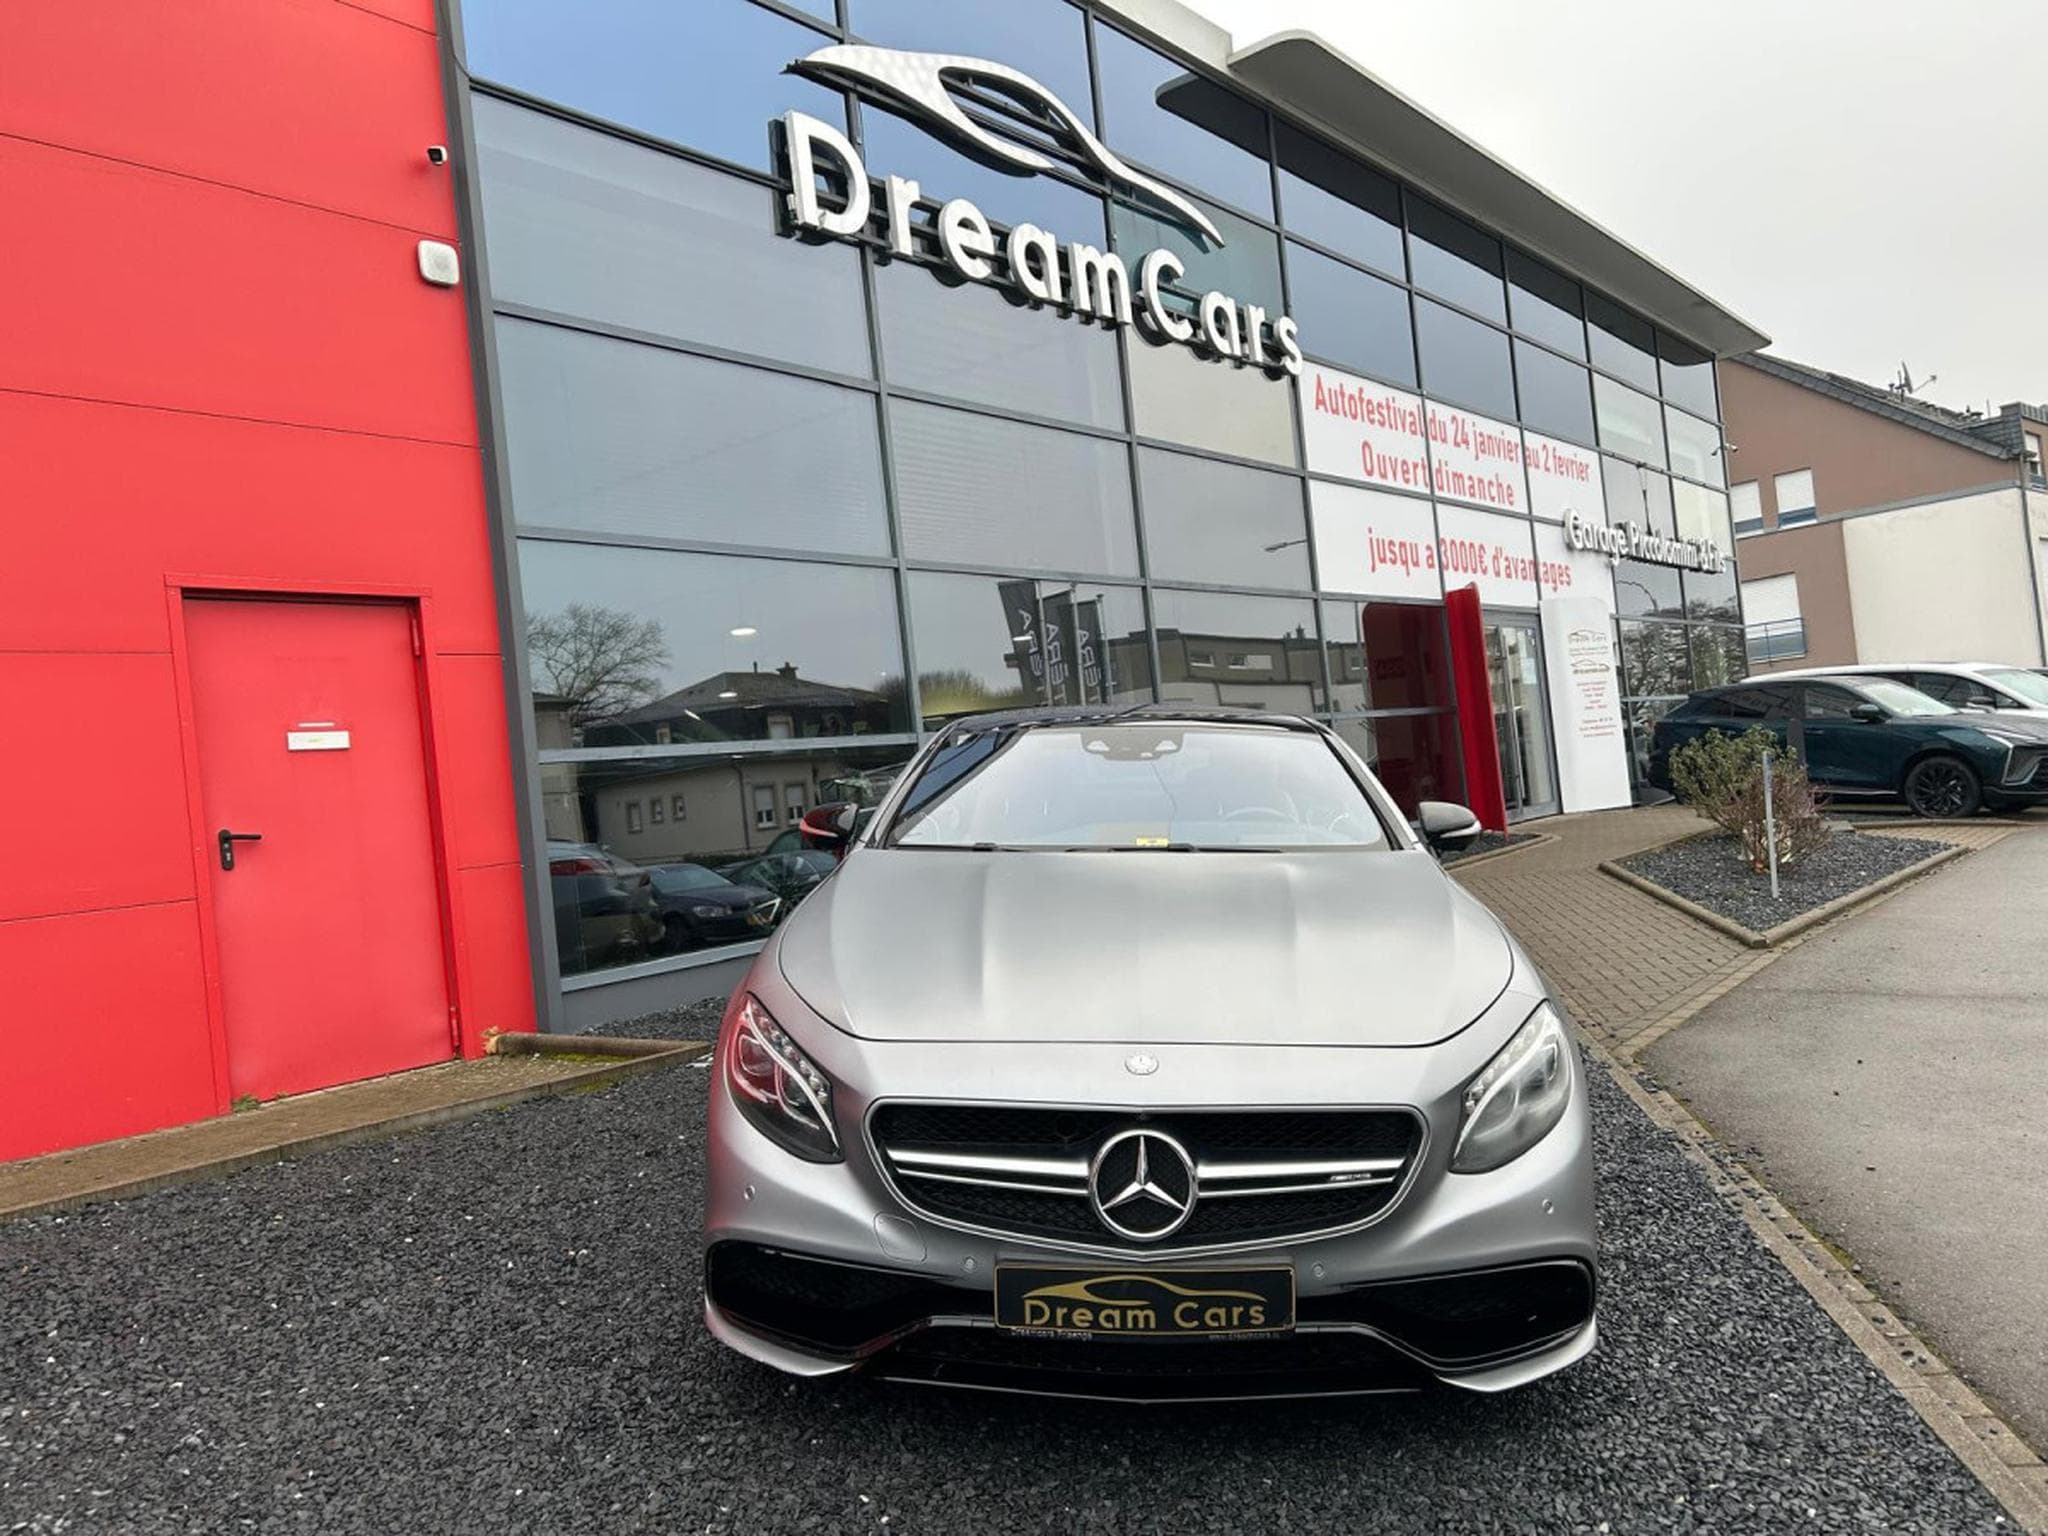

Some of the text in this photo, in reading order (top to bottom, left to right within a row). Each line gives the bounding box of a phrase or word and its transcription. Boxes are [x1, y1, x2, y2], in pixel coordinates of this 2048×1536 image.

[1315, 373, 1424, 438] Autofestival
[1428, 409, 1448, 444] du
[1451, 414, 1470, 449] 24
[1472, 422, 1519, 464] janvier
[1525, 444, 1540, 471] au
[1542, 444, 1551, 473] 2
[1361, 440, 1515, 506] Ouvert dimanche
[1368, 527, 1572, 593] jusqu a 3000€ d'avanages
[1563, 508, 1629, 567] Garage
[1023, 1299, 1266, 1329] Dream Cars
